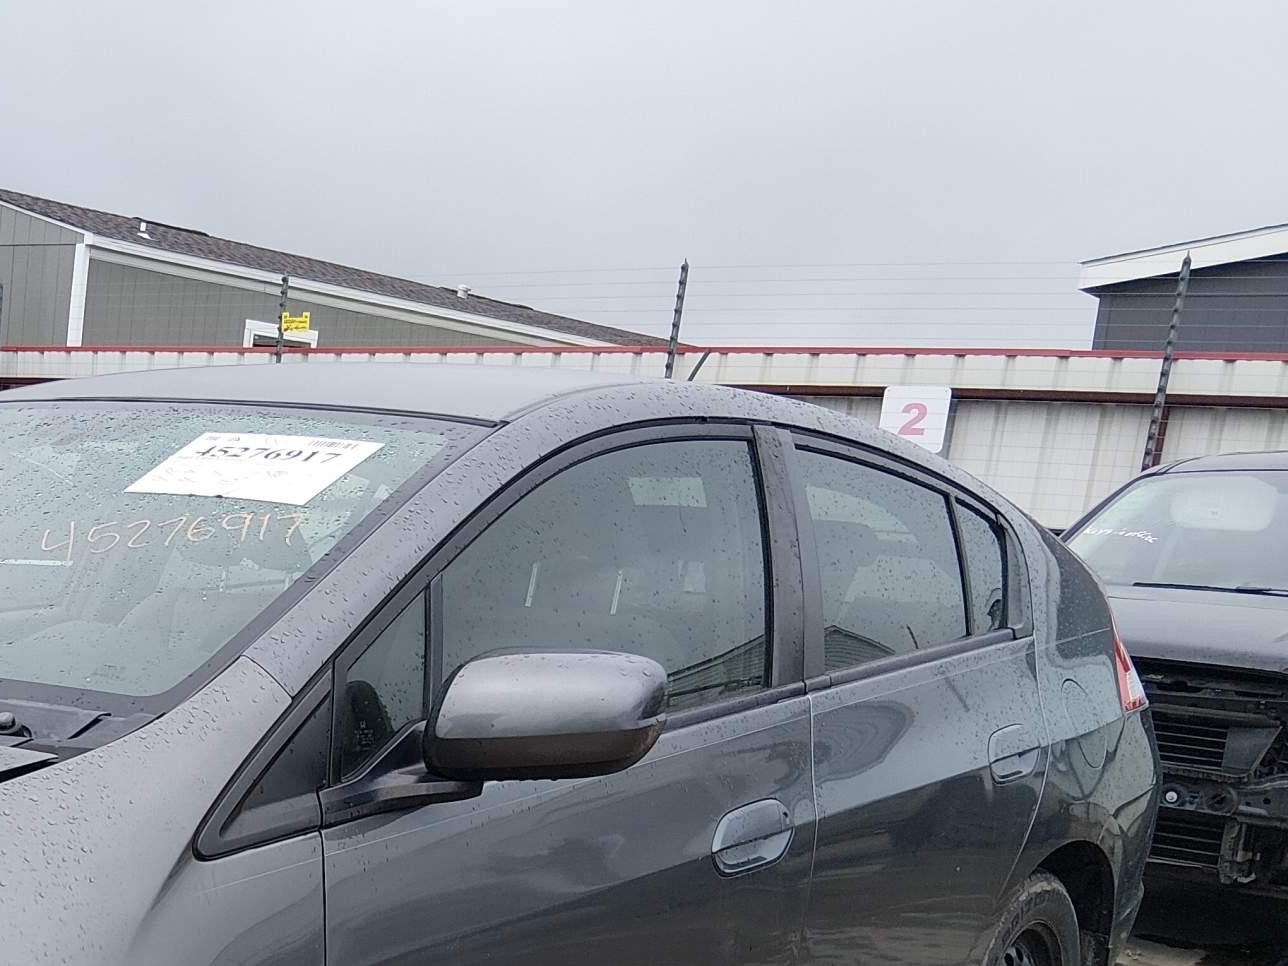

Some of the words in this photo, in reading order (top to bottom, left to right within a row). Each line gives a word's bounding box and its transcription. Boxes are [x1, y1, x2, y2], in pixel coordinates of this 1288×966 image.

[897, 403, 928, 436] 2
[196, 446, 342, 464] 45276917
[40, 512, 302, 567] 45276917
